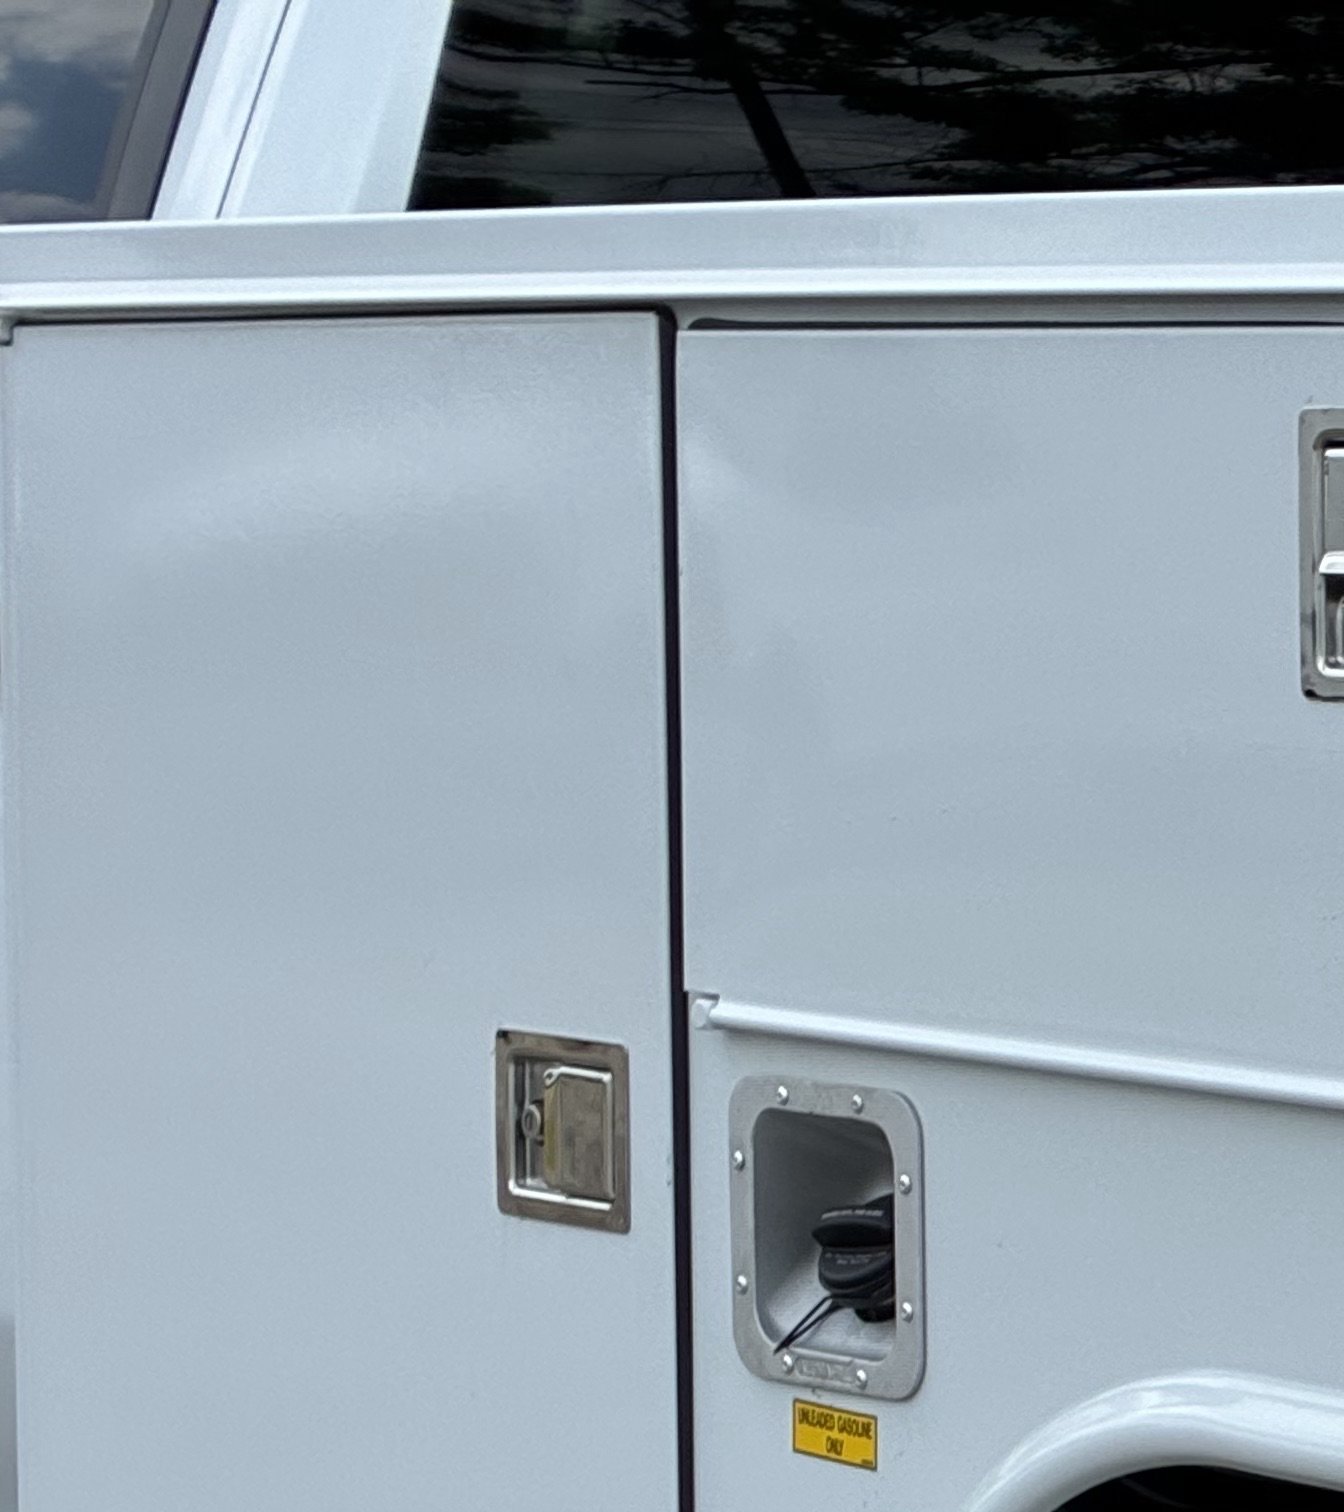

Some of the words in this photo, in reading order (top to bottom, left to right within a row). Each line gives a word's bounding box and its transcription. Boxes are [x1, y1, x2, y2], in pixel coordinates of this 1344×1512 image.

[797, 1406, 835, 1431] UNLEADED
[837, 1414, 873, 1440] GASOLINE
[825, 1434, 845, 1457] ONLY
